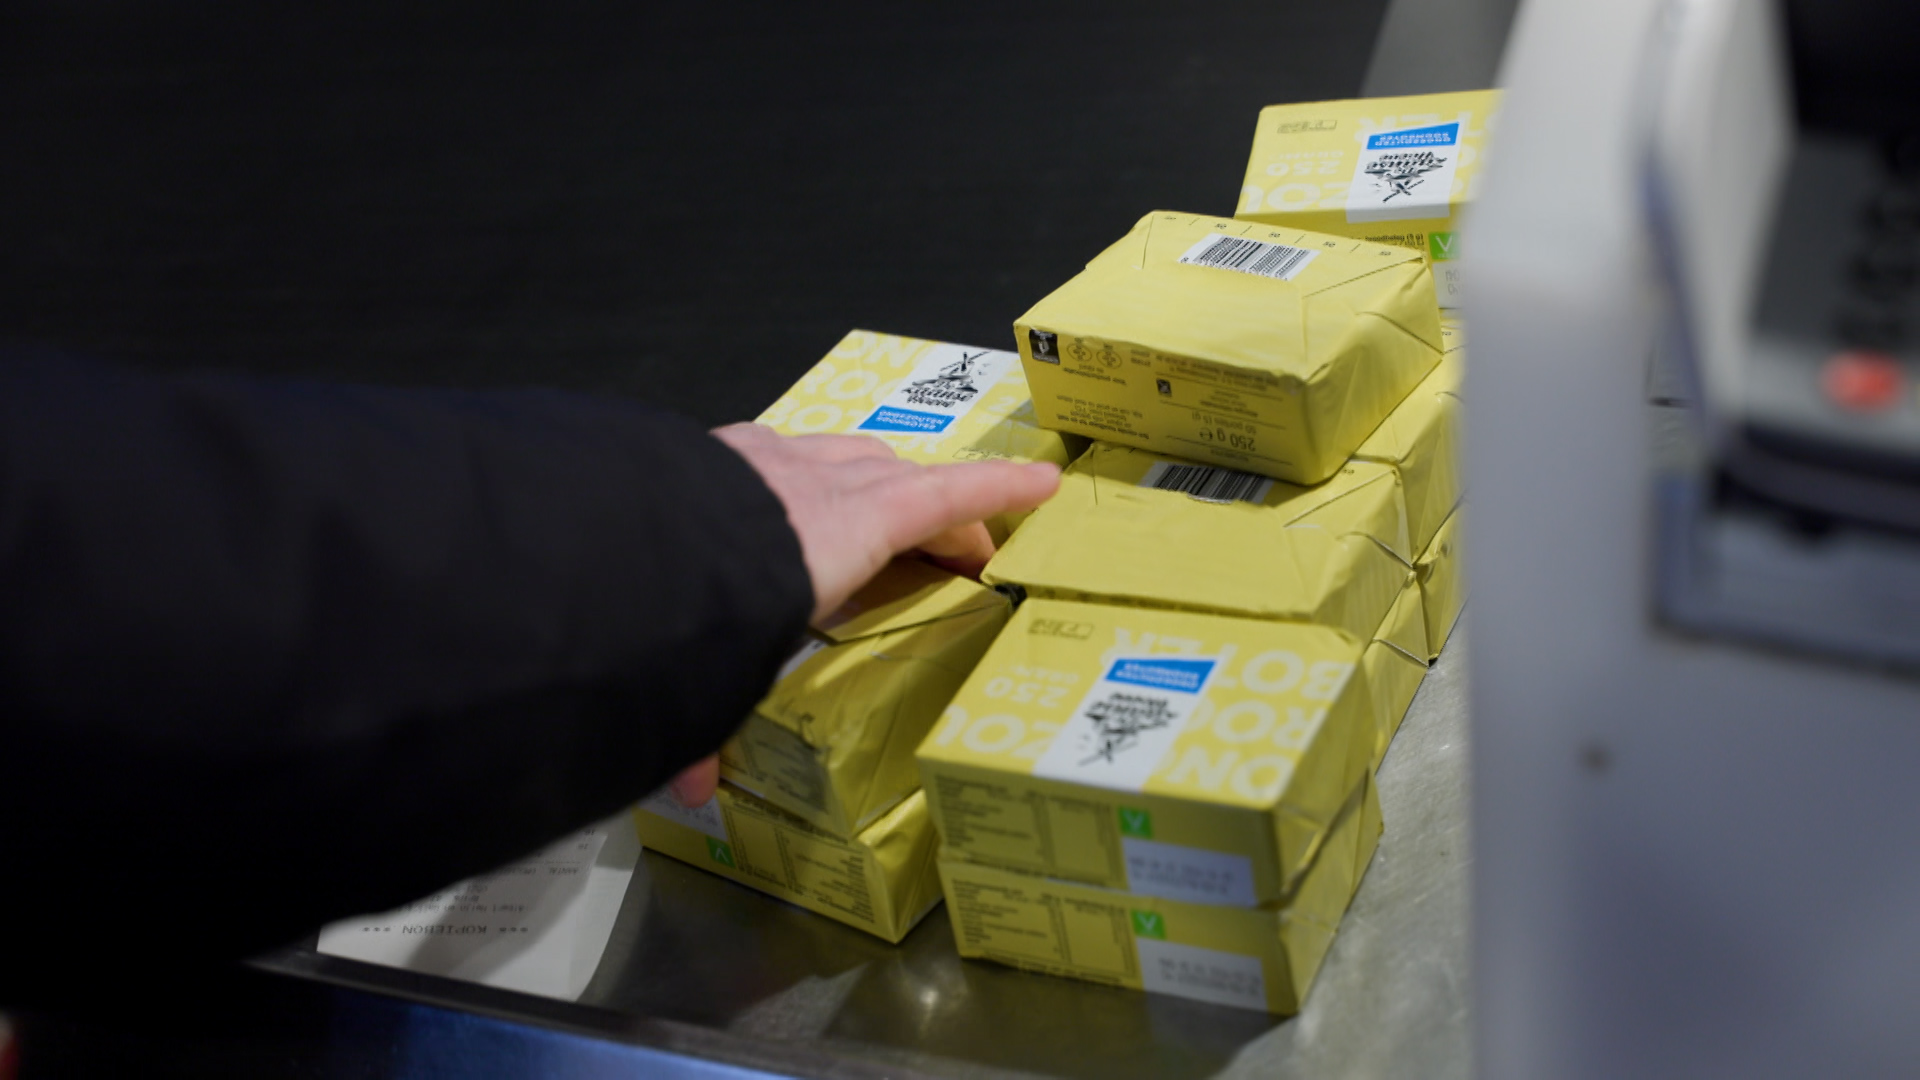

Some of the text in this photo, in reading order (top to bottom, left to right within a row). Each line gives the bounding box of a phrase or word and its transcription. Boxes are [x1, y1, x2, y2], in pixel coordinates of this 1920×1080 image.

[1266, 160, 1341, 176] 250
[1218, 431, 1255, 452] 250 g
[983, 675, 1070, 710] 250
[401, 925, 488, 936] KOPIEBON
